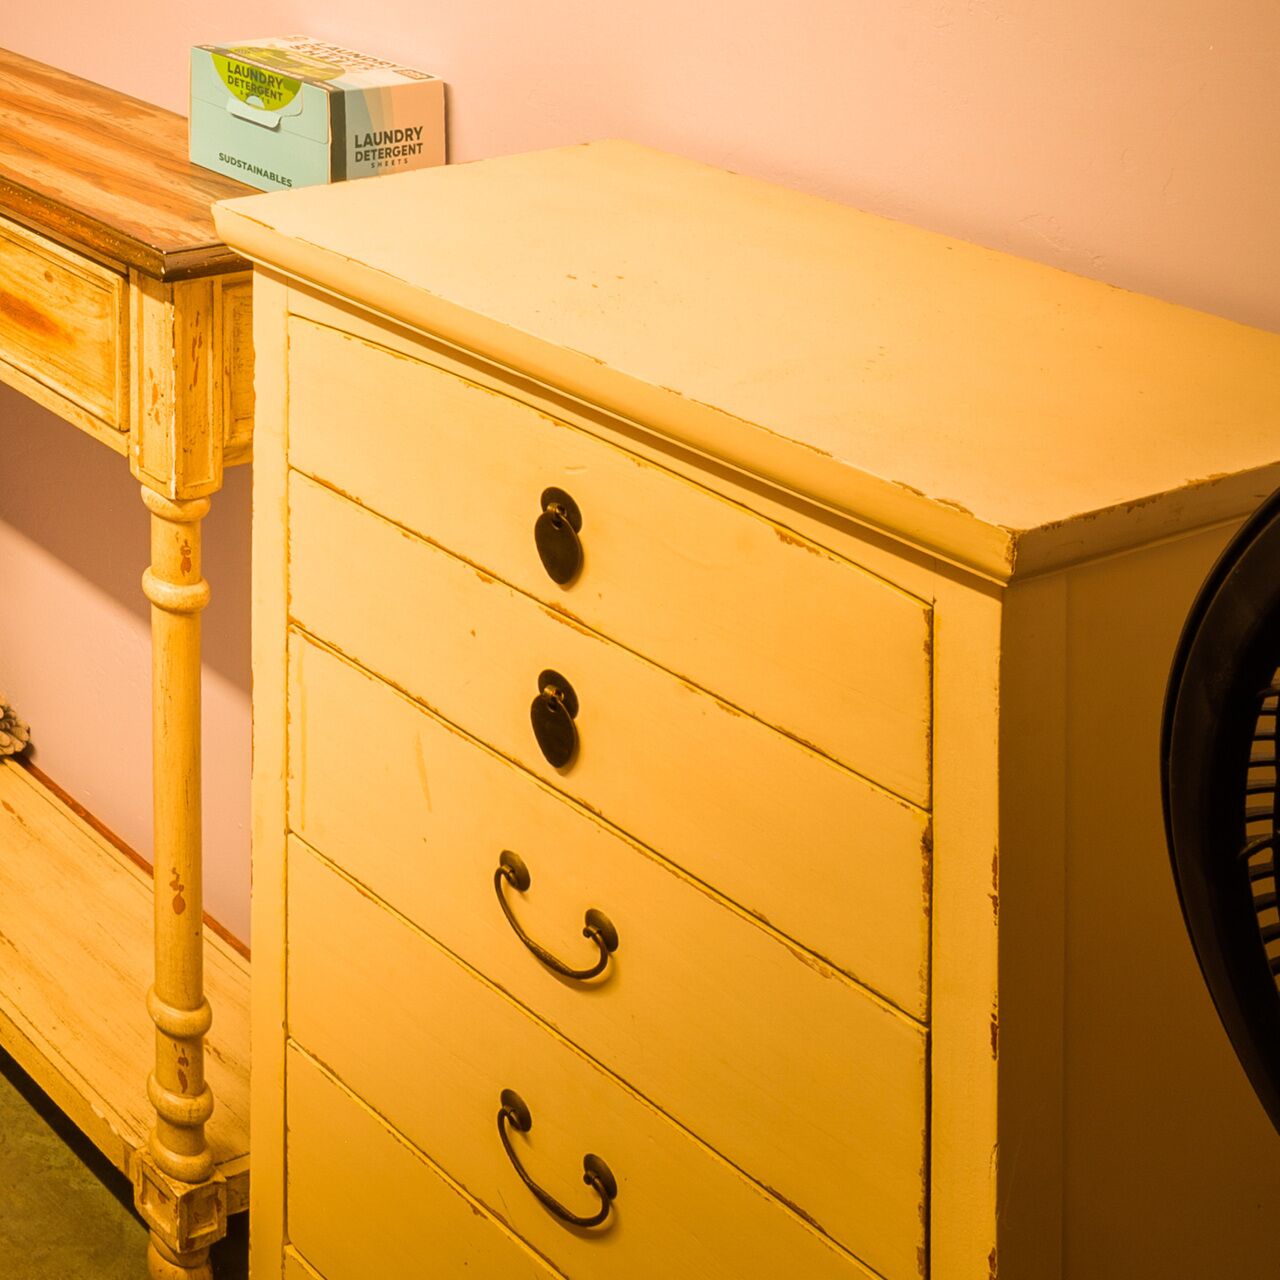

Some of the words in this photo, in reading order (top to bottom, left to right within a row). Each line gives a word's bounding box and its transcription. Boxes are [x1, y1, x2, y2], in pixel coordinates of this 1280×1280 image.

[227, 61, 283, 90] LAUNDRY
[227, 75, 283, 102] DETERGENT
[354, 125, 423, 148] LAUNDRY
[354, 142, 423, 162] DETERGENT
[370, 158, 408, 168] SHEETS
[218, 152, 292, 188] SUDSTAINABLES
